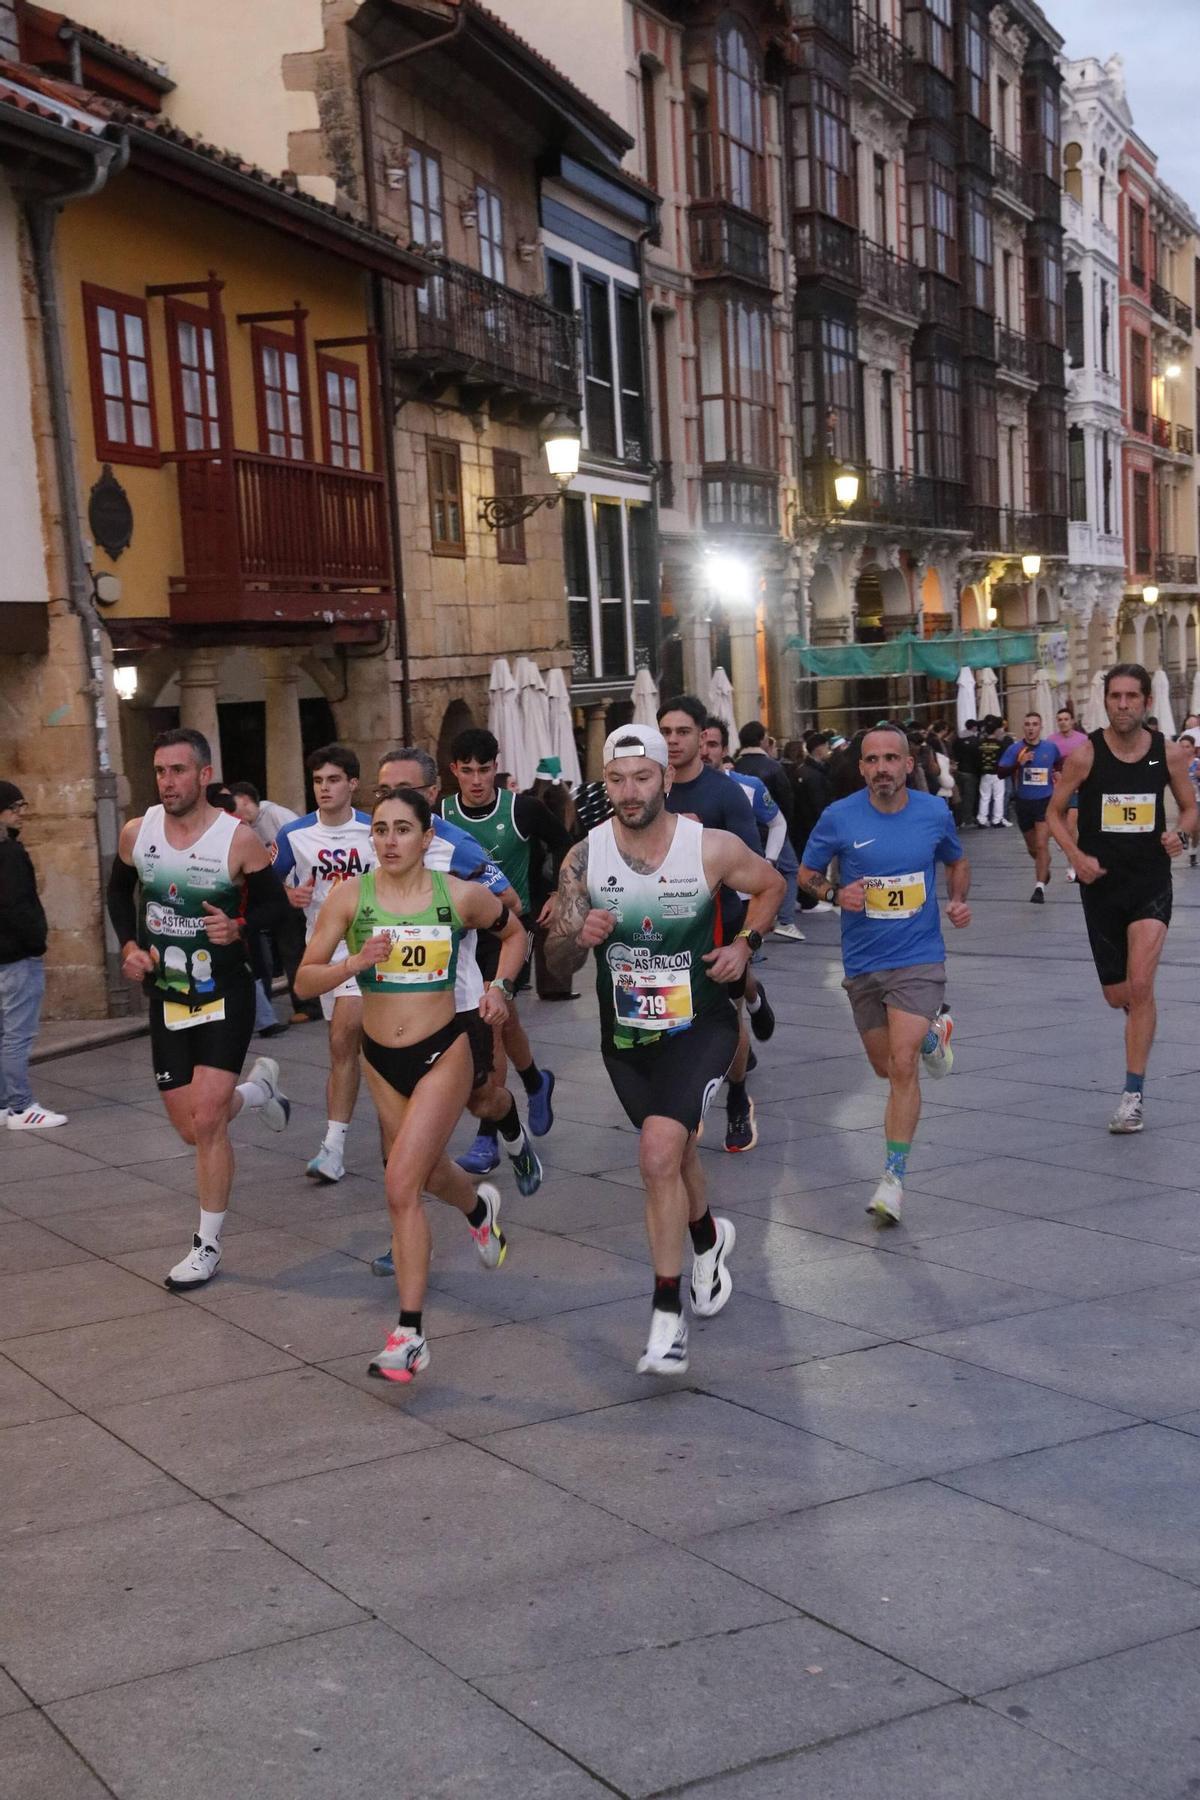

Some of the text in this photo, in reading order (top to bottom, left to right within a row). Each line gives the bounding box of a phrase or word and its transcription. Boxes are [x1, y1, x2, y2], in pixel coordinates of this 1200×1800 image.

[1122, 807, 1137, 822] 15
[887, 890, 904, 907] 21
[401, 945, 426, 967] 20
[637, 995, 666, 1015] 219
